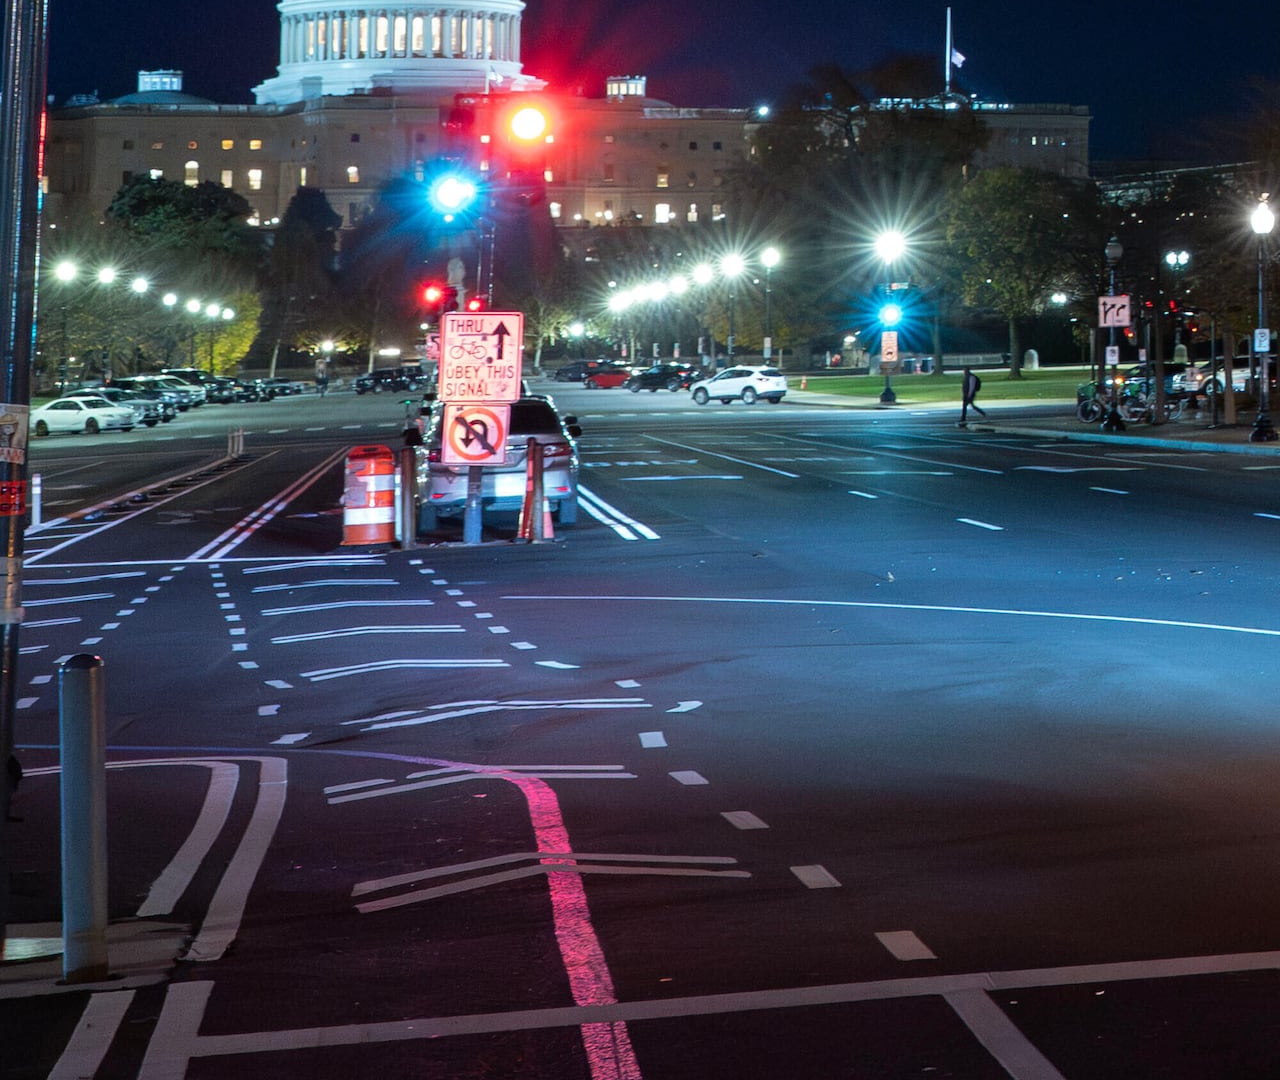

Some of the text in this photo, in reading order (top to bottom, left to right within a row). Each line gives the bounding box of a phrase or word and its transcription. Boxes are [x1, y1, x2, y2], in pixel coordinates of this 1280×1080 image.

[450, 319, 484, 333] THRU
[487, 365, 514, 379] THIS
[446, 383, 491, 397] SIGNAL
